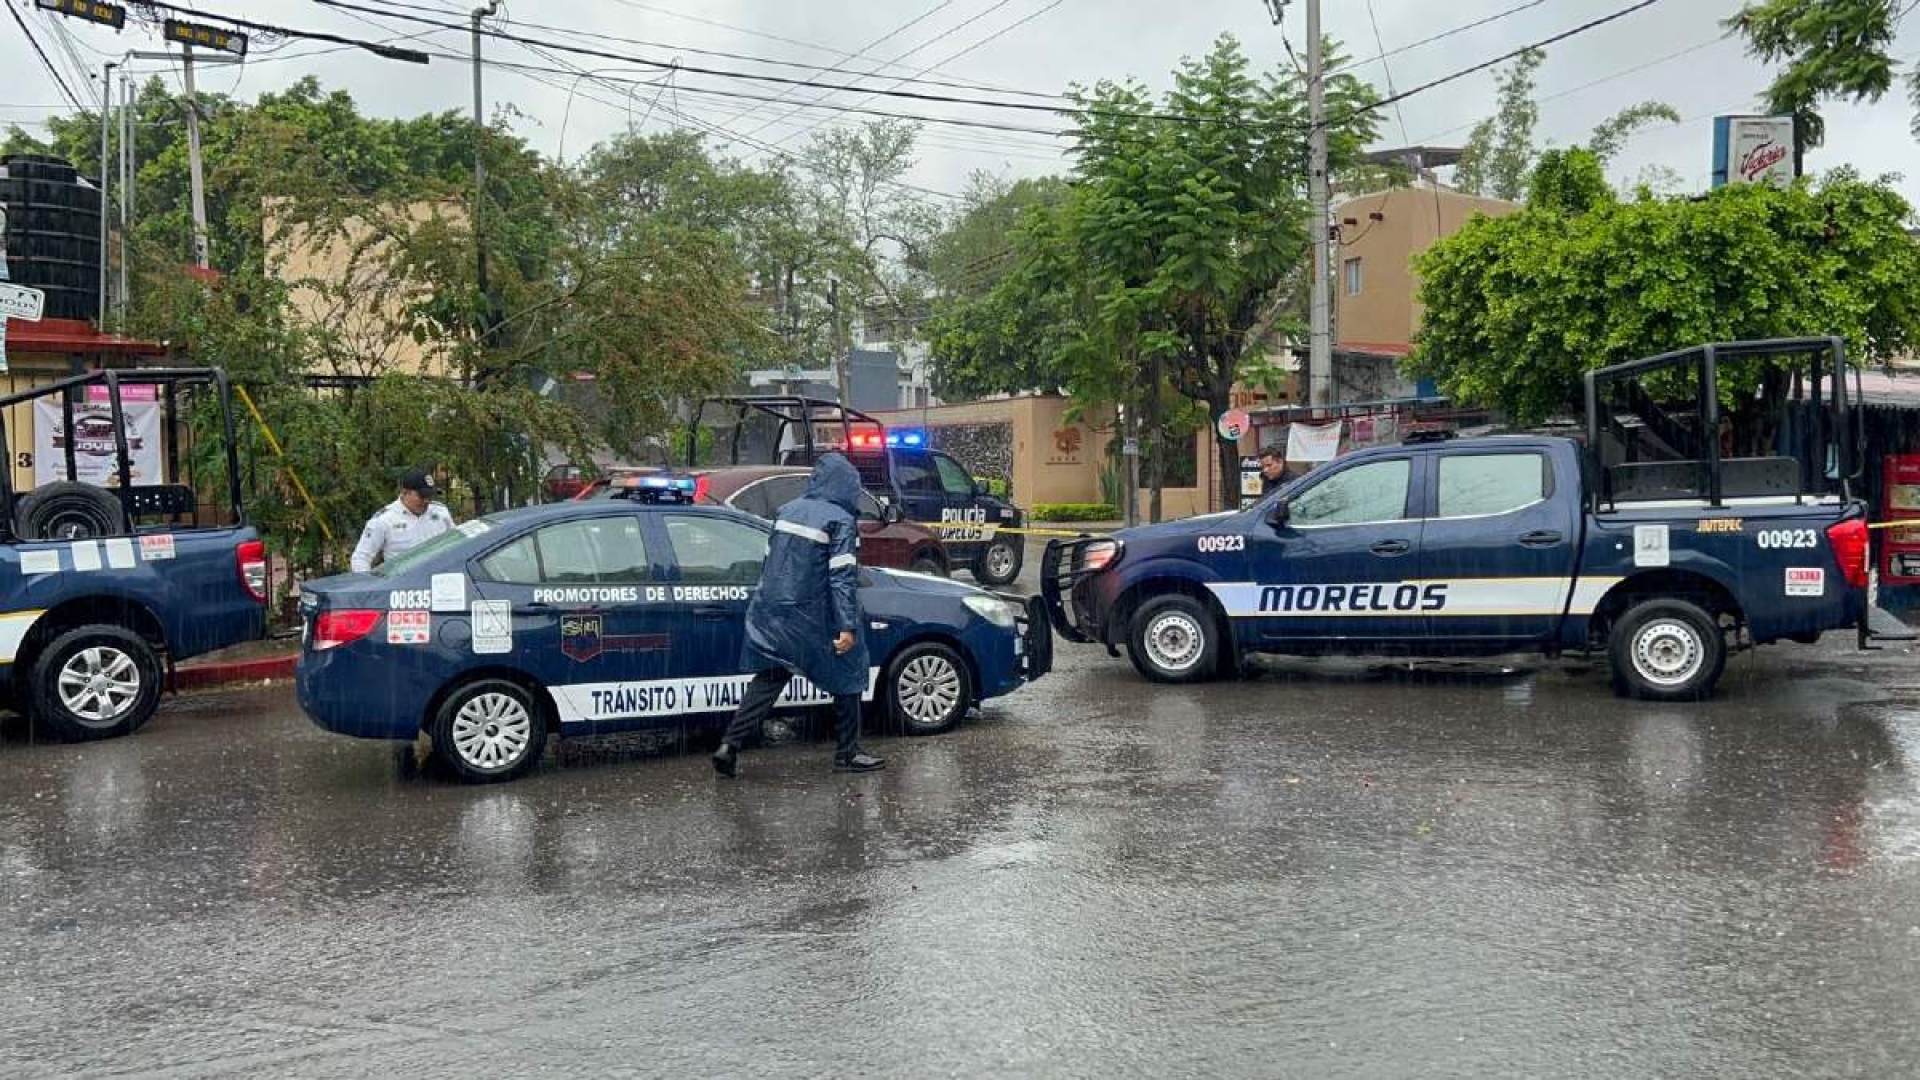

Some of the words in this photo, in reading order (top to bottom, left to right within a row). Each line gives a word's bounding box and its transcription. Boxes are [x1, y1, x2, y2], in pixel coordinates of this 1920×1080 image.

[1197, 534, 1245, 553] 00923
[1758, 530, 1817, 548] 00923
[389, 589, 431, 609] 00835
[533, 586, 638, 603] PROMOTORES
[646, 586, 666, 602] DE
[673, 585, 748, 601] DERECHOS
[1258, 583, 1449, 612] MORELOS
[591, 684, 676, 715] TRÁNSITO
[684, 684, 695, 708] Y
